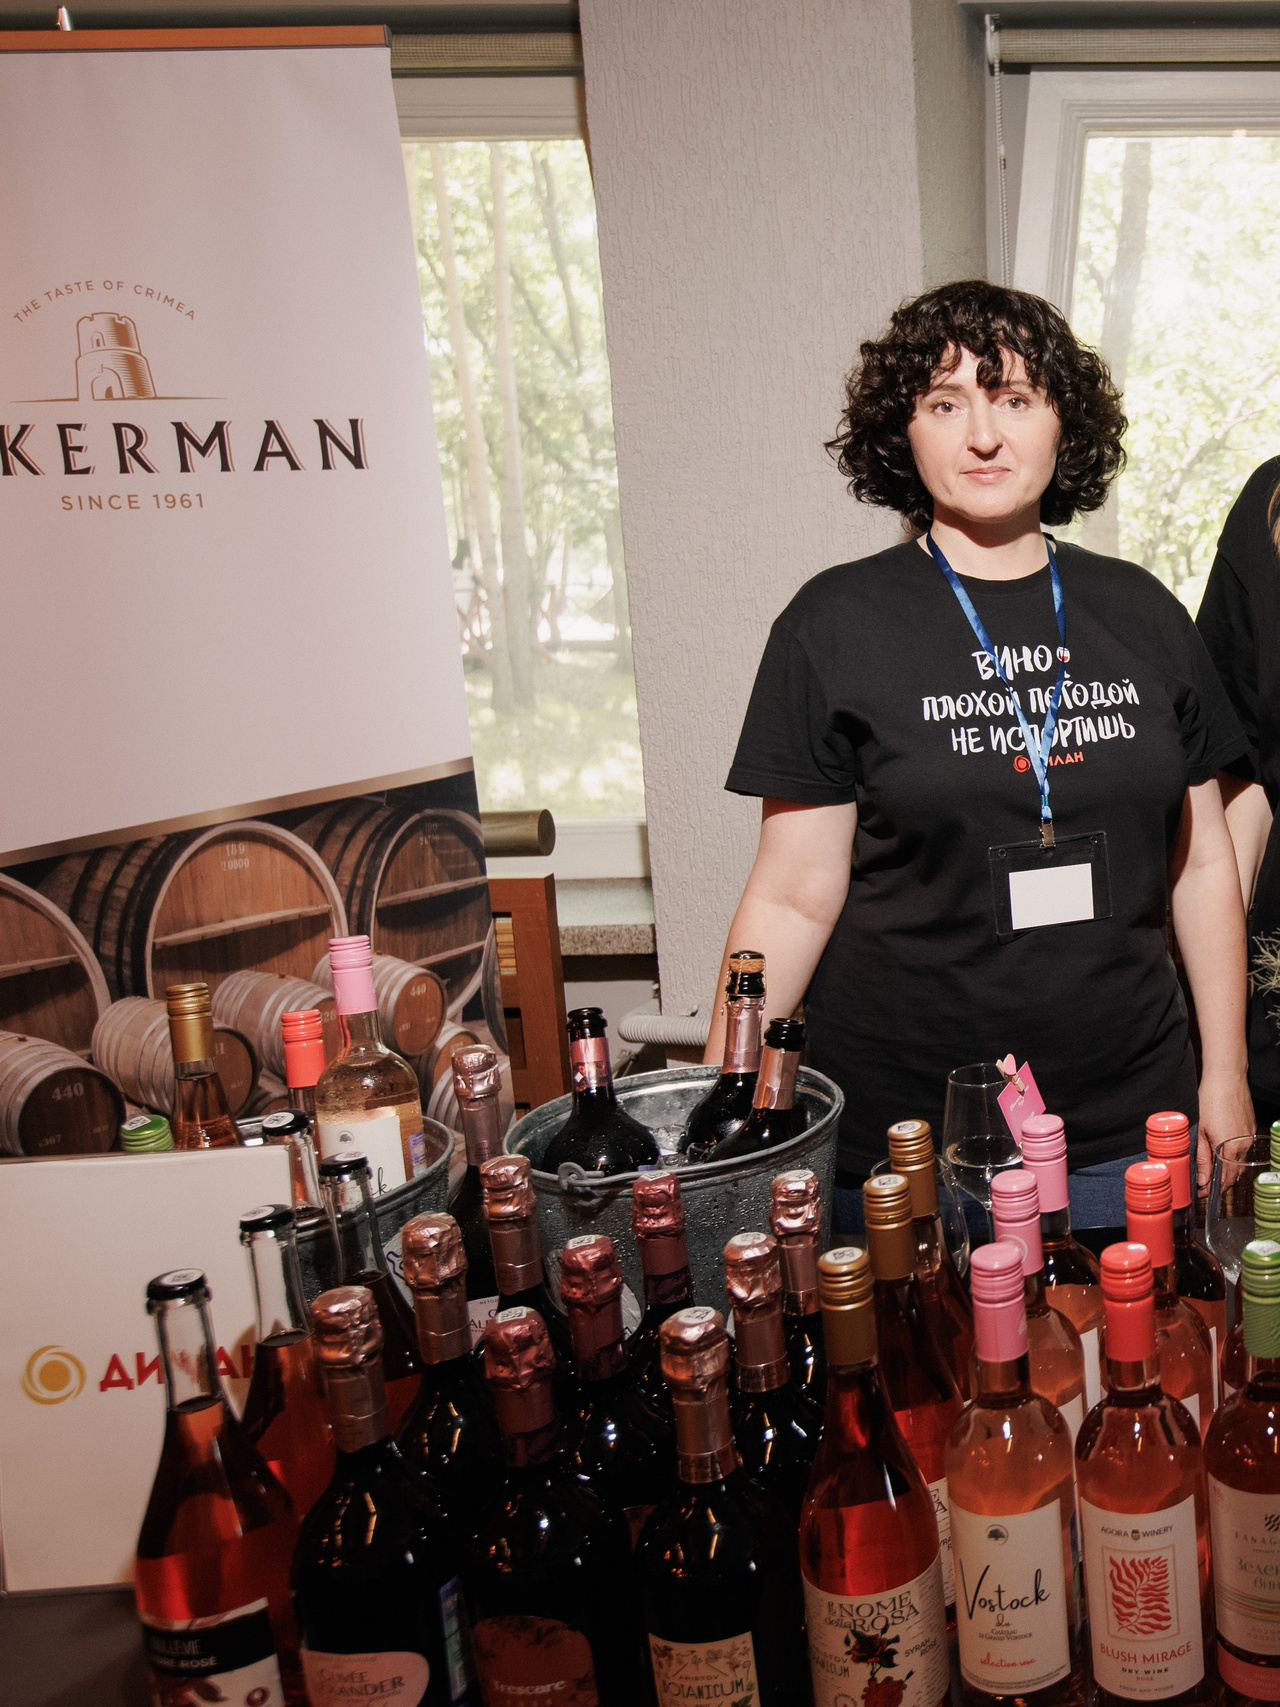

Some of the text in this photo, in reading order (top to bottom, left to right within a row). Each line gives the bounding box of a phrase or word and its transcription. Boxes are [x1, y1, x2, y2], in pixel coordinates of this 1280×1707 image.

[14, 280, 196, 324] THE TASTE OF CRIMEA
[61, 493, 204, 511] SINCE 1961
[972, 644, 1053, 680] ВИНО
[922, 687, 1022, 722] ПЛОХОЙ
[952, 727, 984, 755] НЕ
[410, 984, 427, 997] 440
[52, 1083, 84, 1100] 440
[1101, 1525, 1174, 1538] AGORA WINERY
[960, 1558, 1051, 1620] Vostock
[840, 1591, 911, 1618] NOME
[851, 1604, 919, 1633] ROSA
[904, 1637, 931, 1658] SYRAH
[1100, 1641, 1192, 1664] BLUSH MIRAGE
